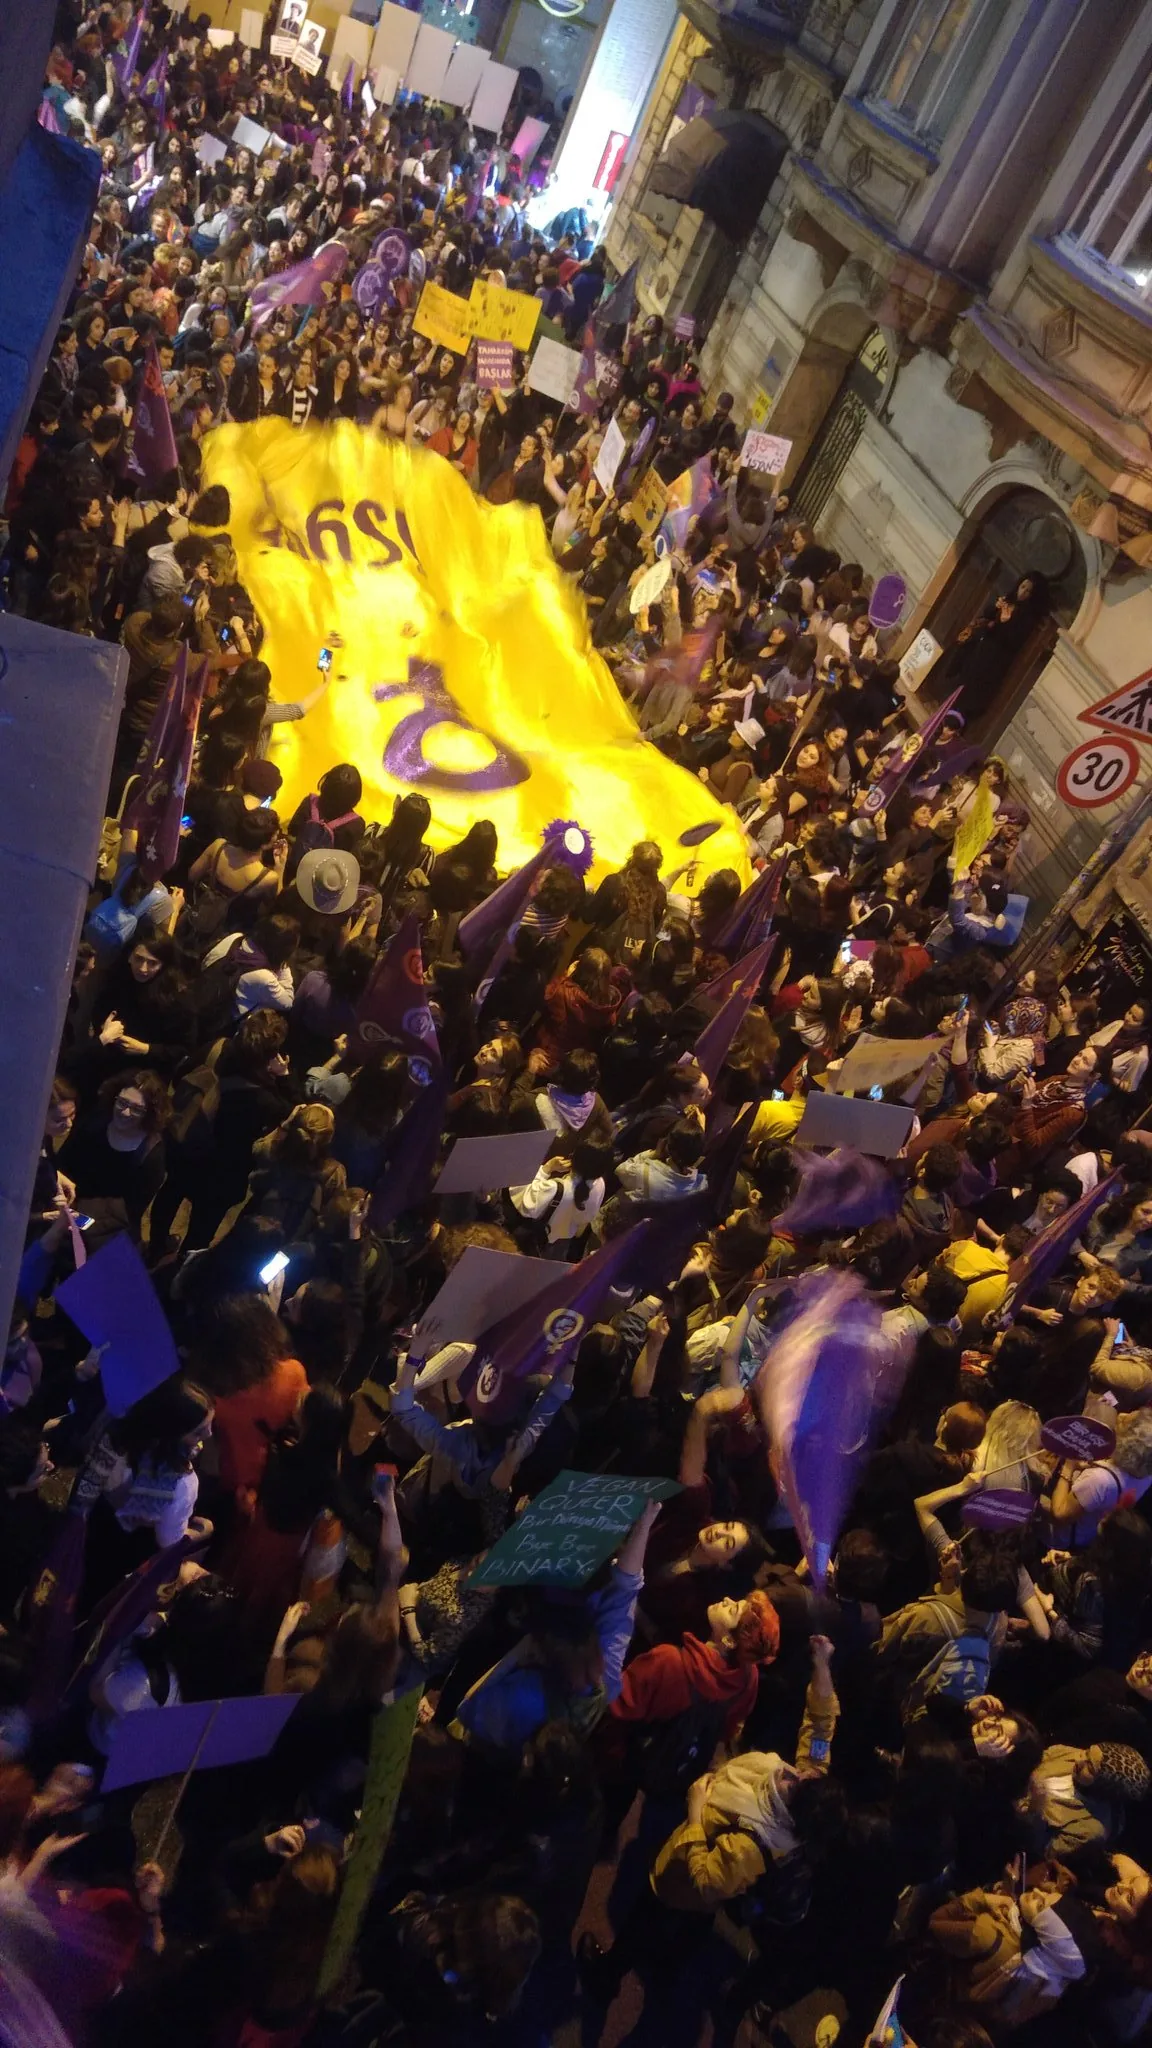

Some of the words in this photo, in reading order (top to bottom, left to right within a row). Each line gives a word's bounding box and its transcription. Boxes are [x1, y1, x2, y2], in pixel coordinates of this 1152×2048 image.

[1072, 752, 1123, 792] 30
[568, 1477, 667, 1493] VEGAN
[538, 1494, 634, 1519] QUEER
